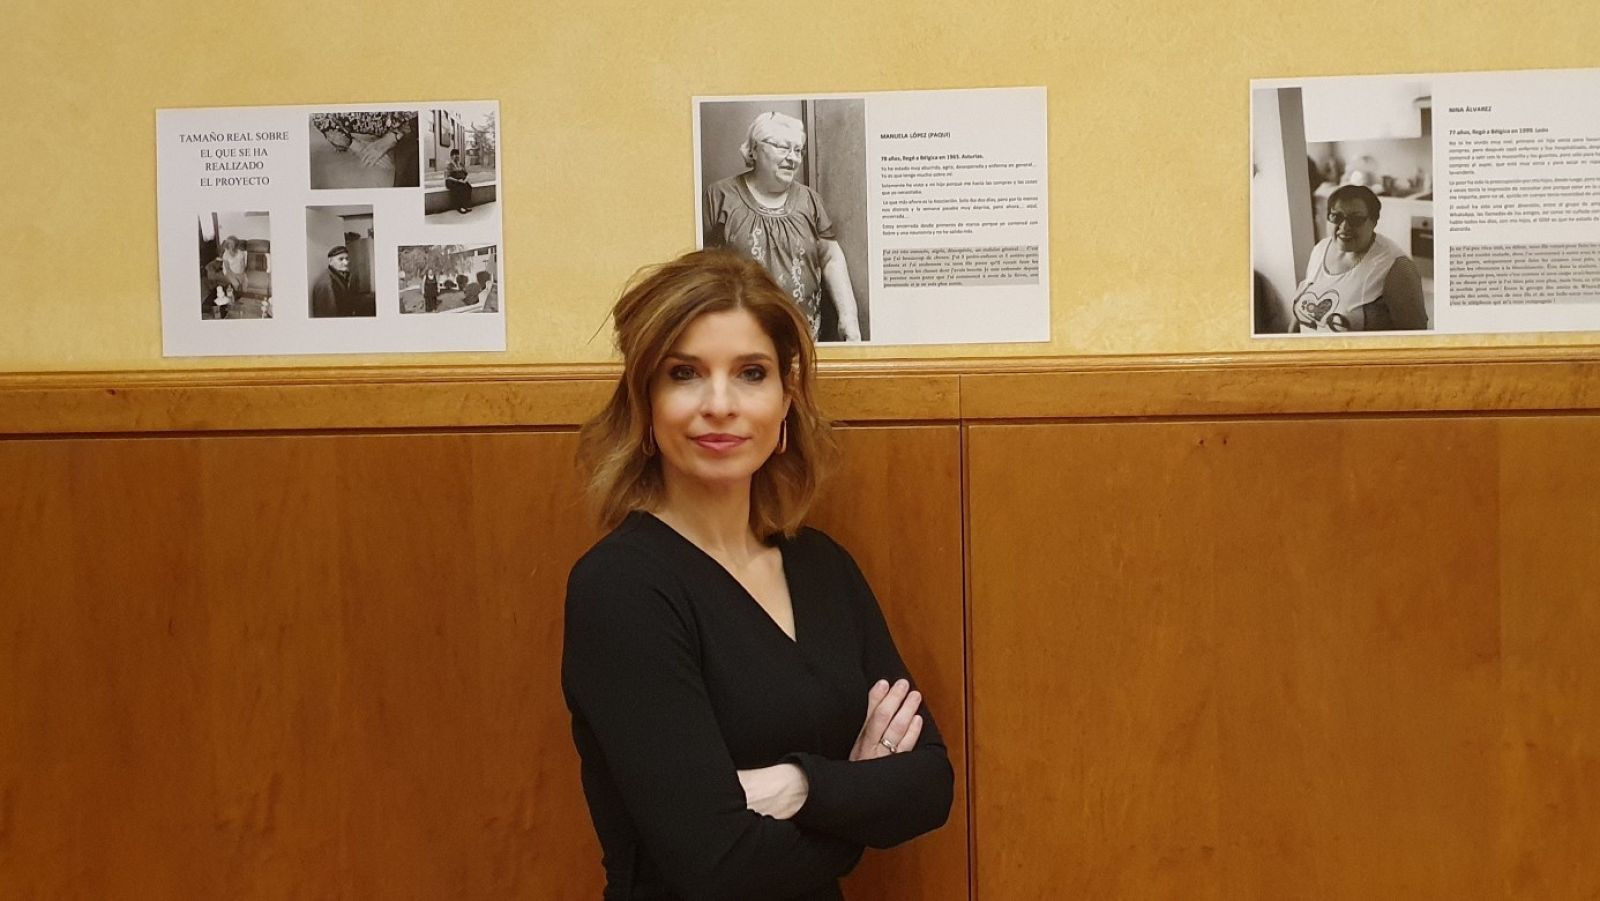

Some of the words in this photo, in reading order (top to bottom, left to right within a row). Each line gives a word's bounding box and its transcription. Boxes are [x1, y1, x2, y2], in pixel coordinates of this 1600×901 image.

[179, 132, 225, 143] TAMAÑO
[227, 132, 253, 141] REAL
[255, 131, 289, 141] SOBRE
[909, 131, 927, 139] LÓPEZ
[200, 149, 212, 158] EL
[215, 148, 236, 158] QUE
[239, 148, 251, 157] SE
[253, 147, 268, 156] HA
[205, 161, 264, 170] REALIZADO
[200, 178, 212, 186] EL
[215, 176, 270, 186] PROYECTO
